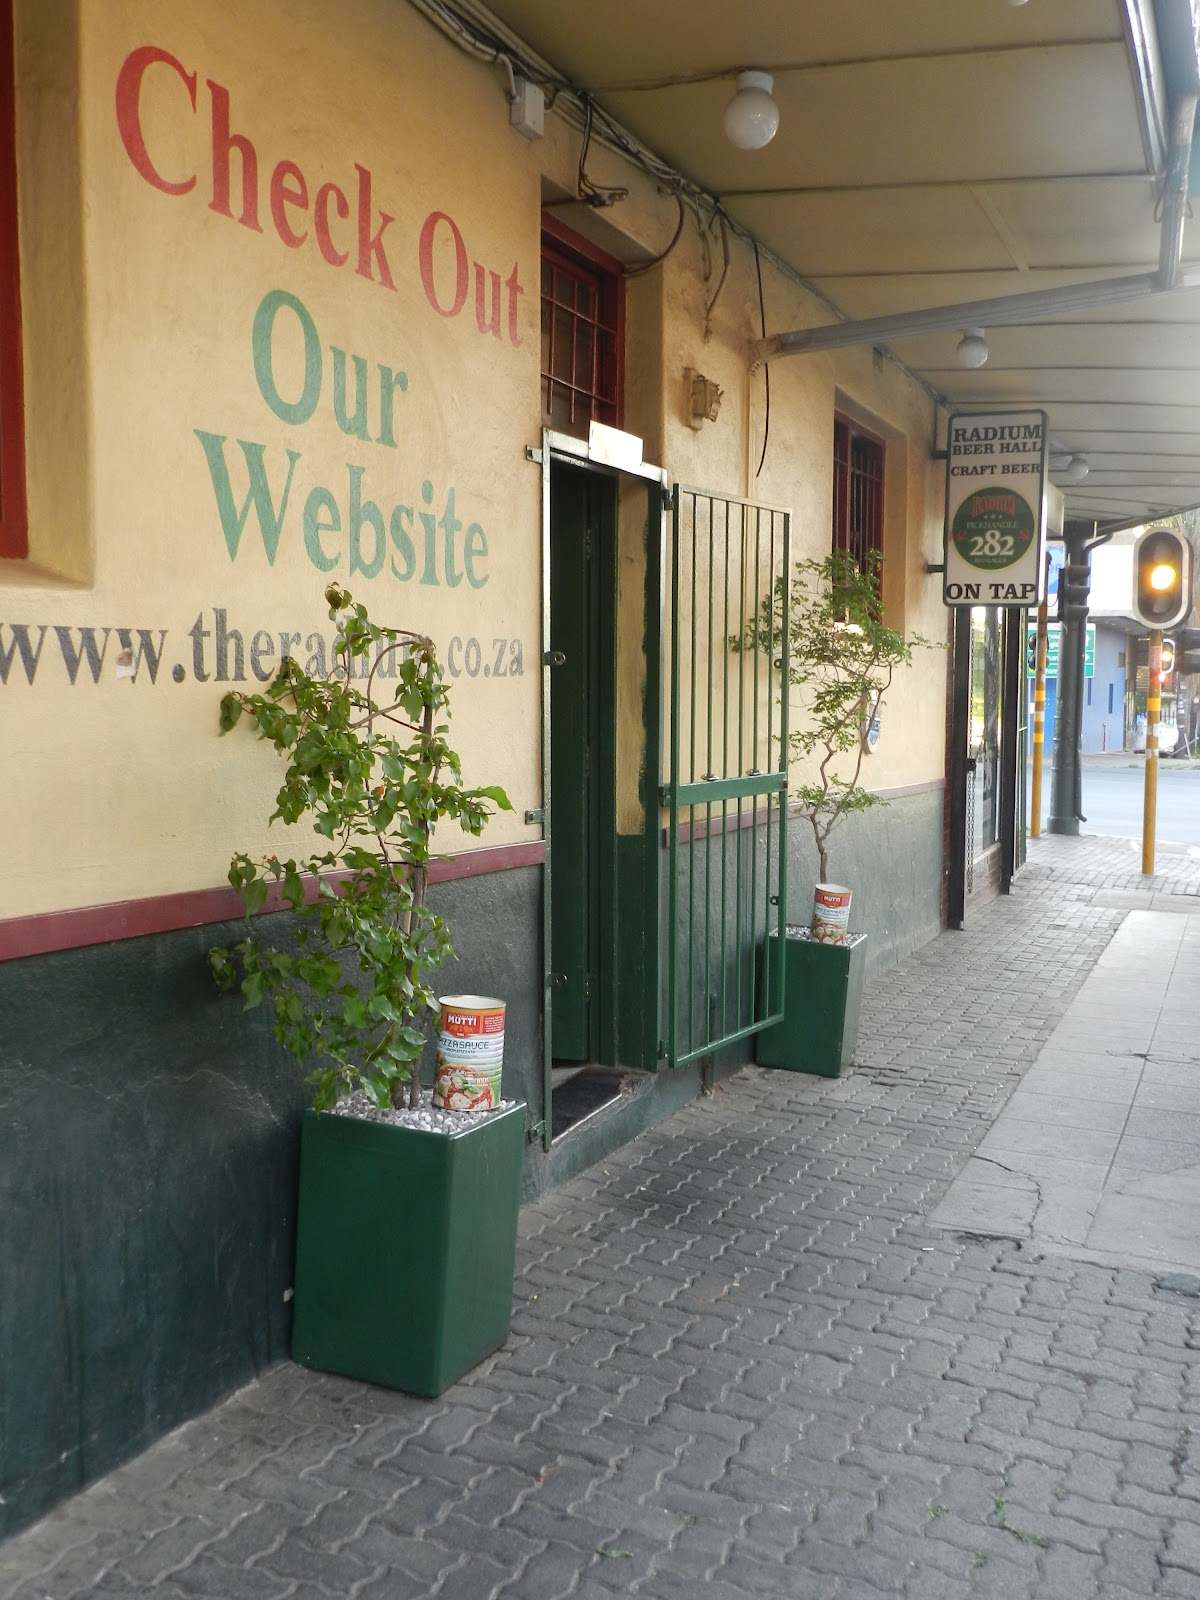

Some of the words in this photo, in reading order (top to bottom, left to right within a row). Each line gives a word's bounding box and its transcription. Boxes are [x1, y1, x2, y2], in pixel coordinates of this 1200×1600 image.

[115, 46, 397, 292] Check
[418, 211, 524, 348] Out
[252, 290, 408, 448] Our
[953, 424, 1041, 442] RADIUM
[952, 444, 994, 456] BEER
[999, 442, 1042, 453] HALL
[951, 464, 997, 477] CRAFT
[1001, 463, 1041, 475] BEER
[193, 429, 490, 590] Website
[970, 530, 1015, 556] 282
[946, 584, 981, 600] ON
[989, 583, 1036, 600] TAP
[0, 607, 524, 686] www.theradu.co.za
[447, 1015, 477, 1026] MUTTI
